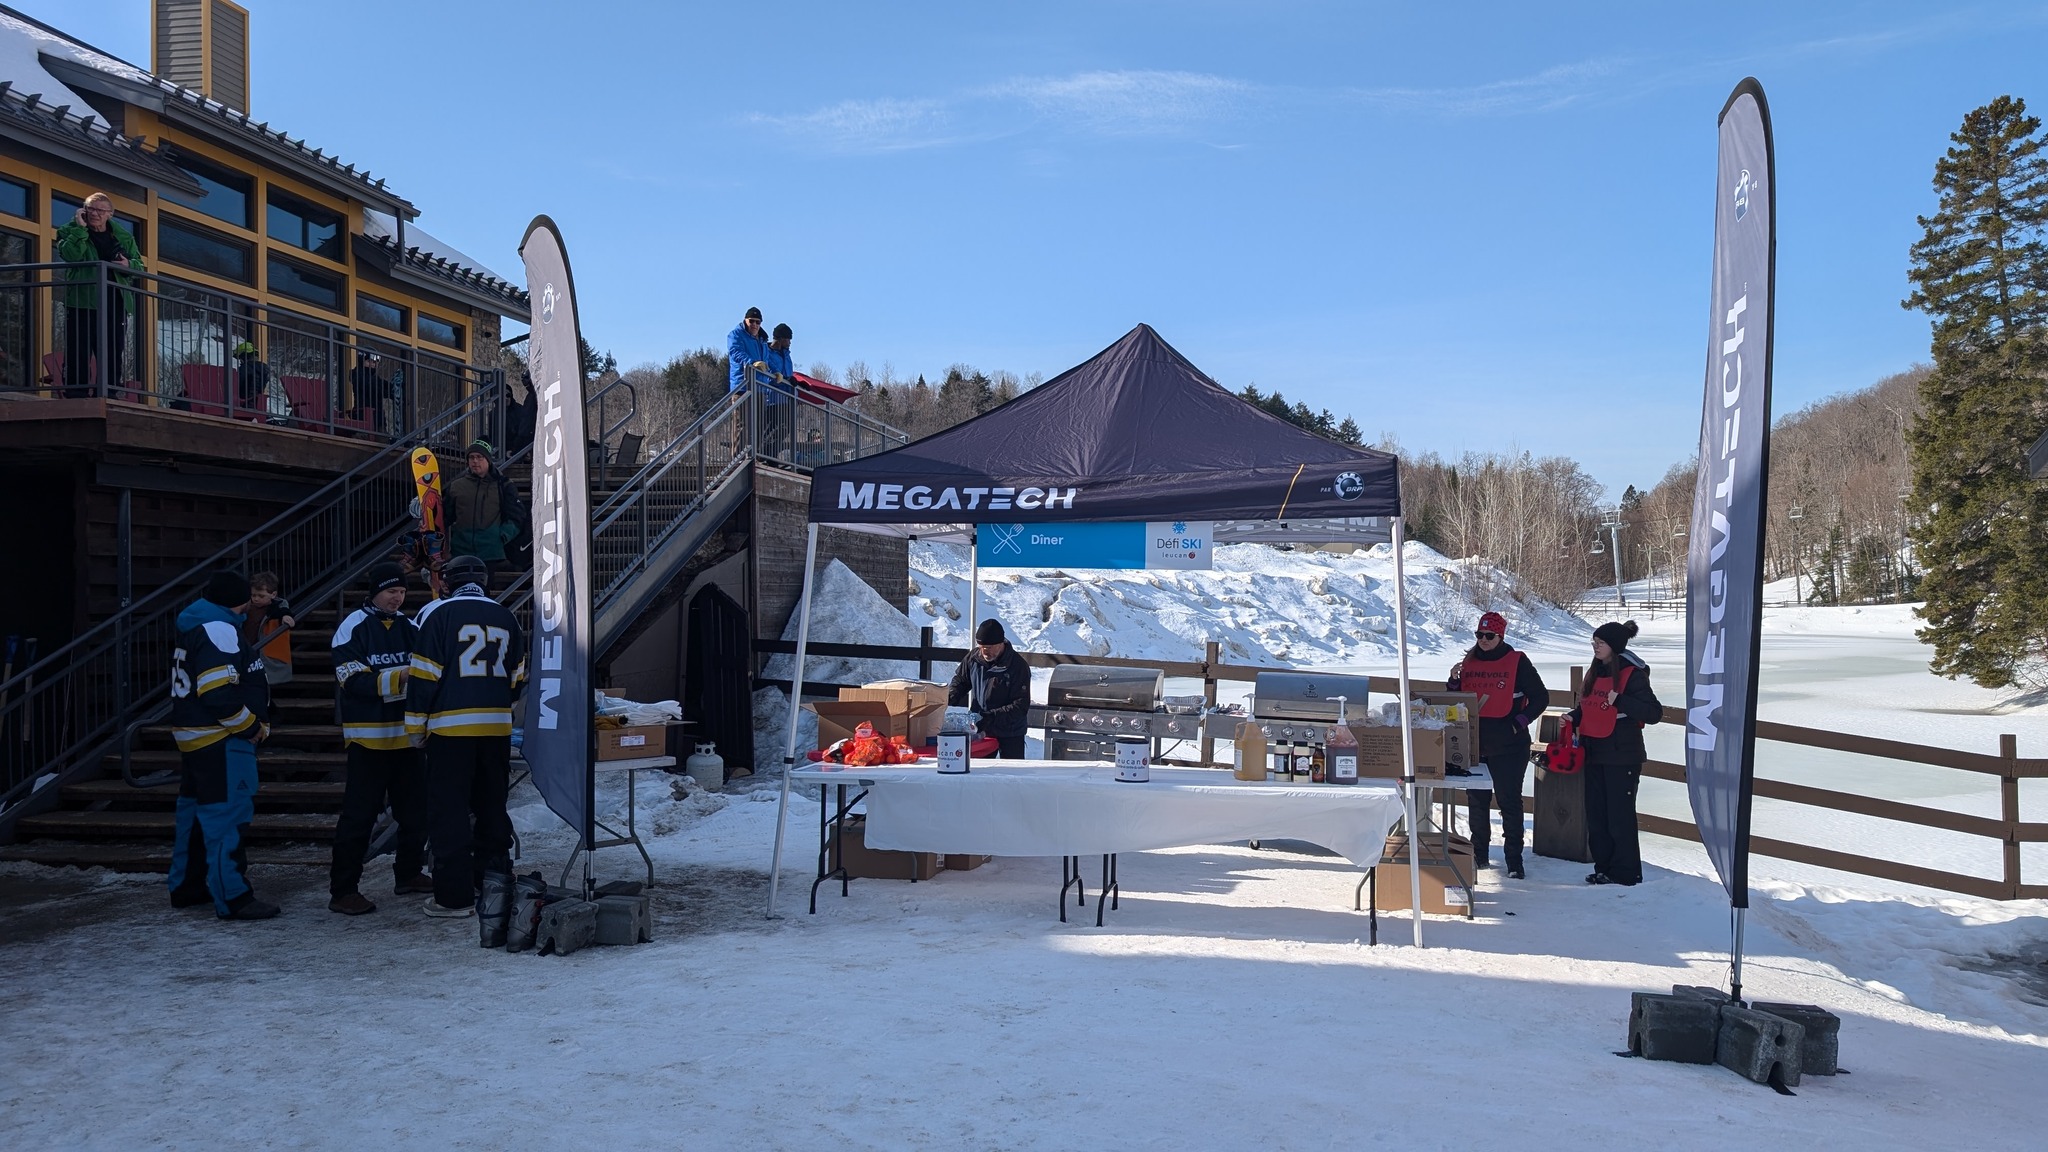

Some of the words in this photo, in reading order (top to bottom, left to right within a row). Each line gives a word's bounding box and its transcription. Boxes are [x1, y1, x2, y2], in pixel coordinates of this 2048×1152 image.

[838, 481, 1077, 511] MEGATECH
[1031, 534, 1063, 546] Dîner
[1157, 537, 1179, 549] Défi
[1182, 538, 1201, 549] SKI
[457, 624, 510, 678] 27
[171, 647, 191, 699] 5
